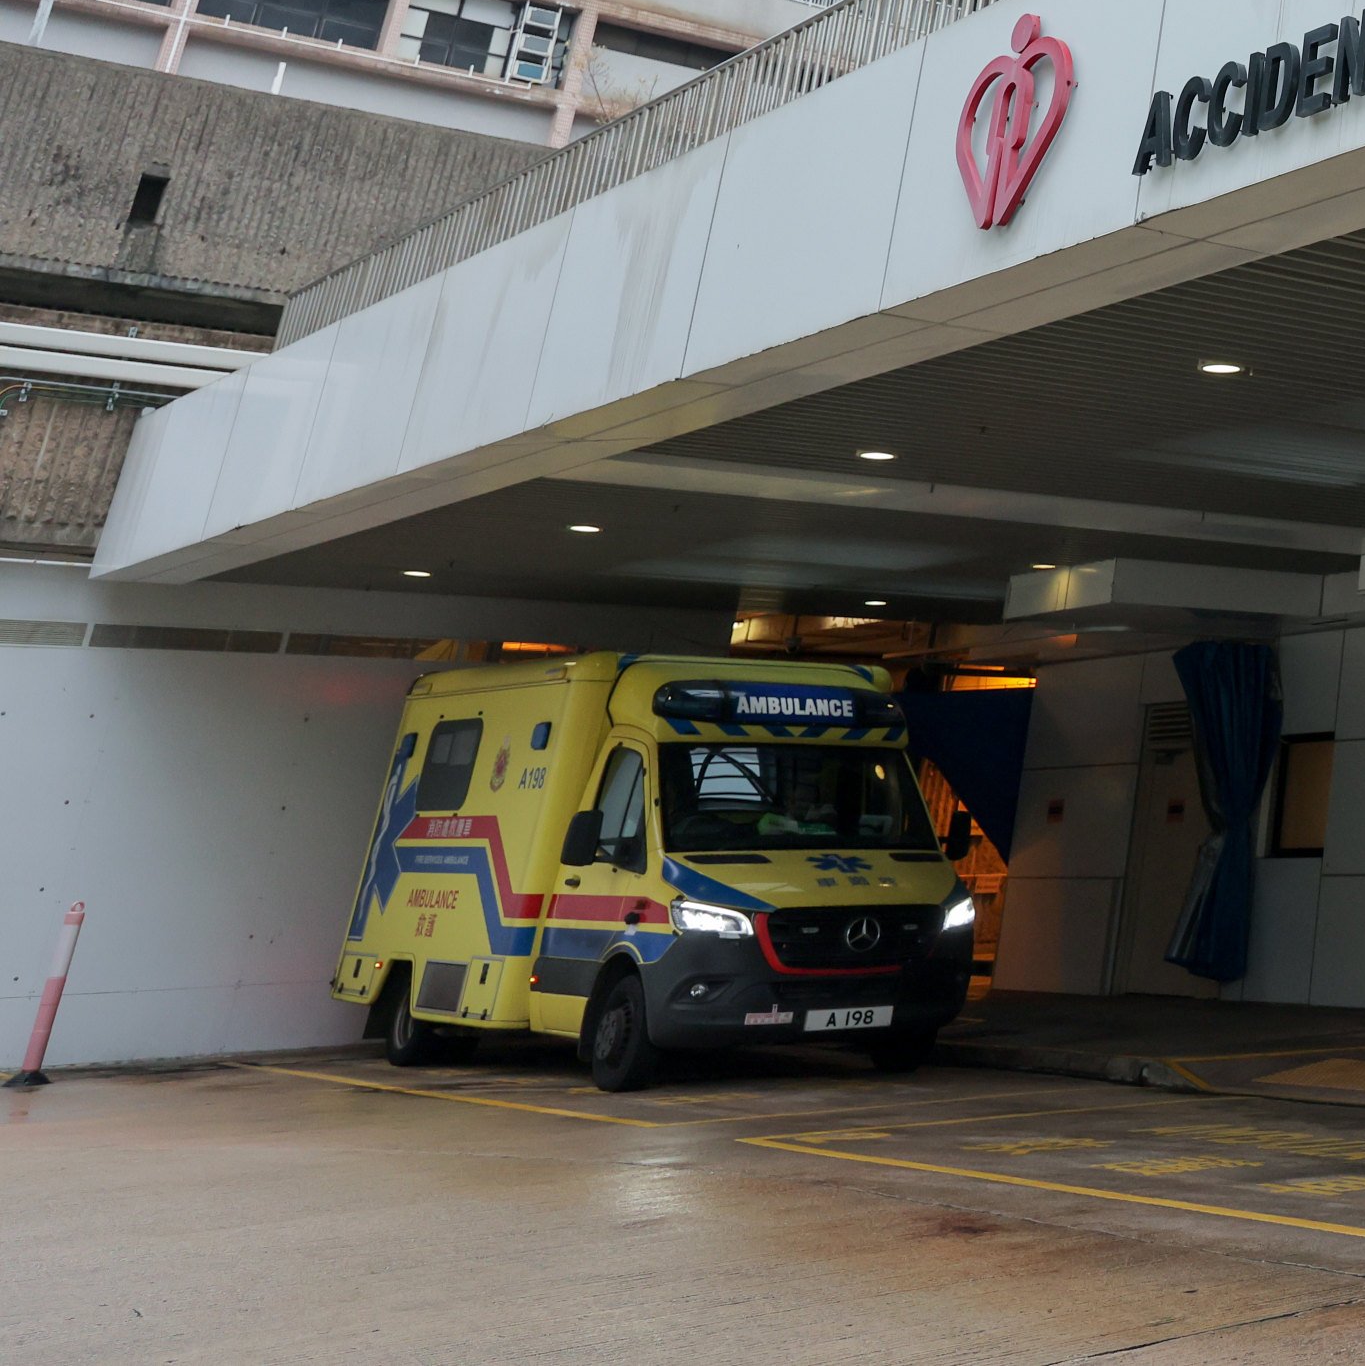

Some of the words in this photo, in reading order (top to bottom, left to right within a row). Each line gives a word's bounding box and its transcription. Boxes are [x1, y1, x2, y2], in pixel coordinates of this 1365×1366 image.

[736, 696, 854, 718] AMBULANCE
[518, 767, 547, 790] A198
[407, 889, 459, 909] AMBULANCE
[826, 1012, 837, 1028] A
[845, 1010, 874, 1026] 198
